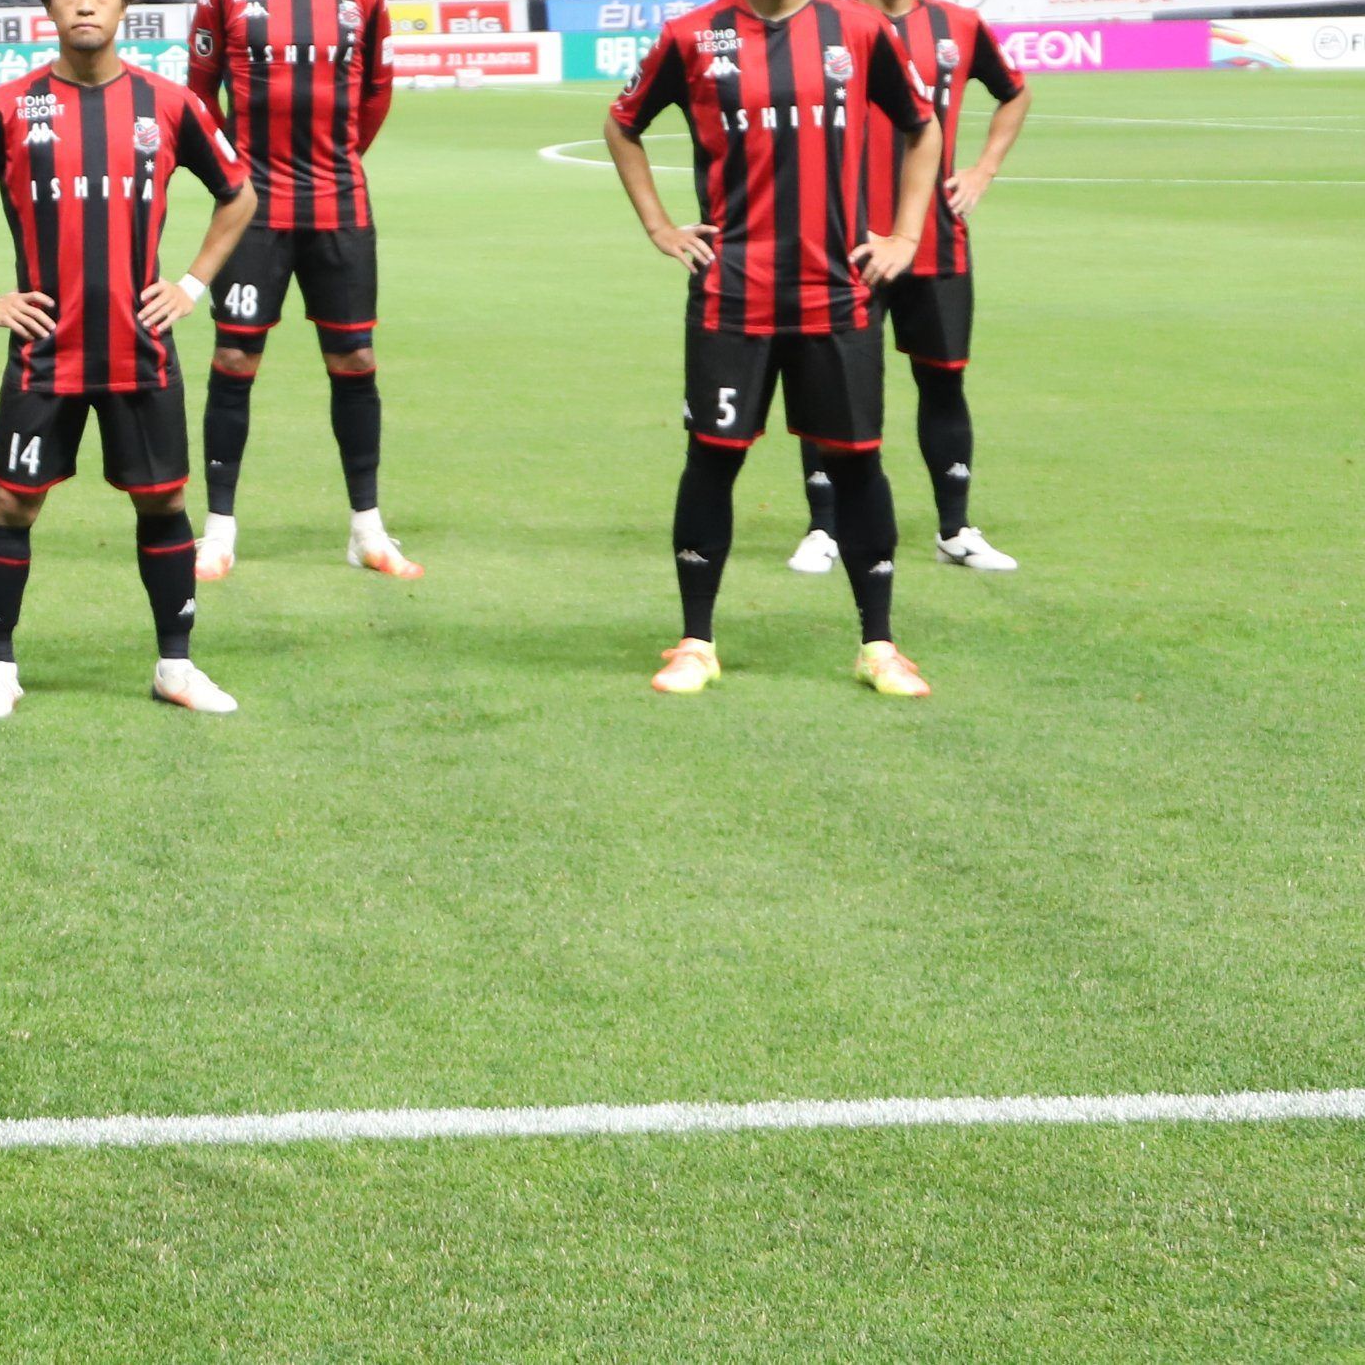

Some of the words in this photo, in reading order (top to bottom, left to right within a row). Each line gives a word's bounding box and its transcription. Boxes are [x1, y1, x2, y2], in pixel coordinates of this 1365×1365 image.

[693, 27, 737, 41] TOHO
[248, 44, 354, 63] ISHIYA
[696, 37, 744, 53] RESORT
[467, 51, 532, 66] LEAGUE
[15, 93, 57, 106] TOHO
[17, 103, 66, 119] RESORT
[722, 105, 846, 132] ISHIYA
[31, 175, 153, 202] ISHIYA
[224, 282, 259, 318] 48
[715, 386, 738, 427] 5
[7, 431, 42, 475] 14
